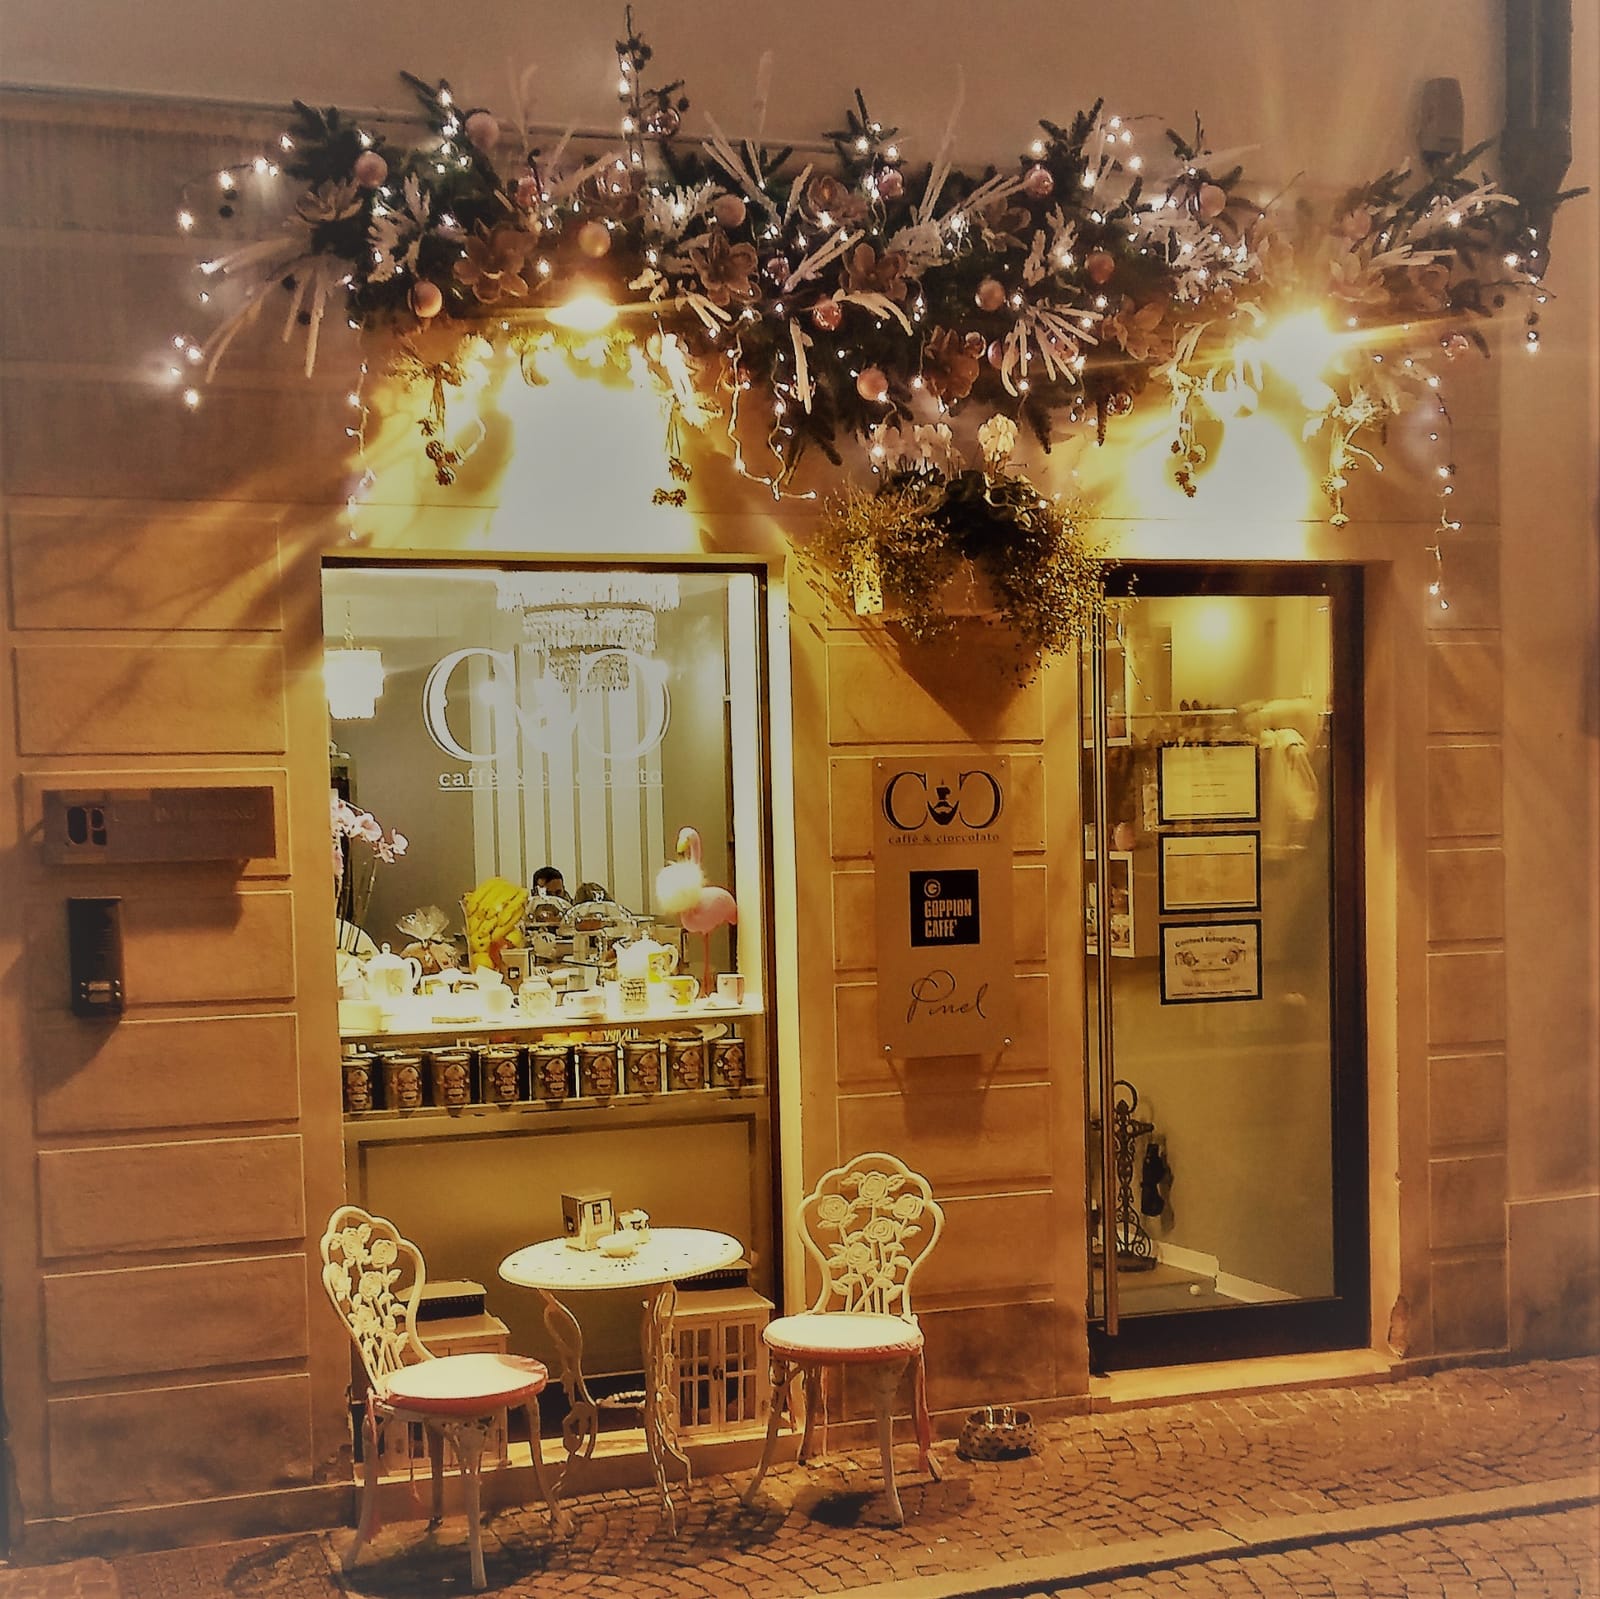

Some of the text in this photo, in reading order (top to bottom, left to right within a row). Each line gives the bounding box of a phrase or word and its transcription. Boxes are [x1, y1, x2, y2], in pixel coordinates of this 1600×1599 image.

[935, 832, 1000, 845] cioccolato
[924, 898, 972, 918] GOPPION
[907, 969, 989, 1024] Pinel
